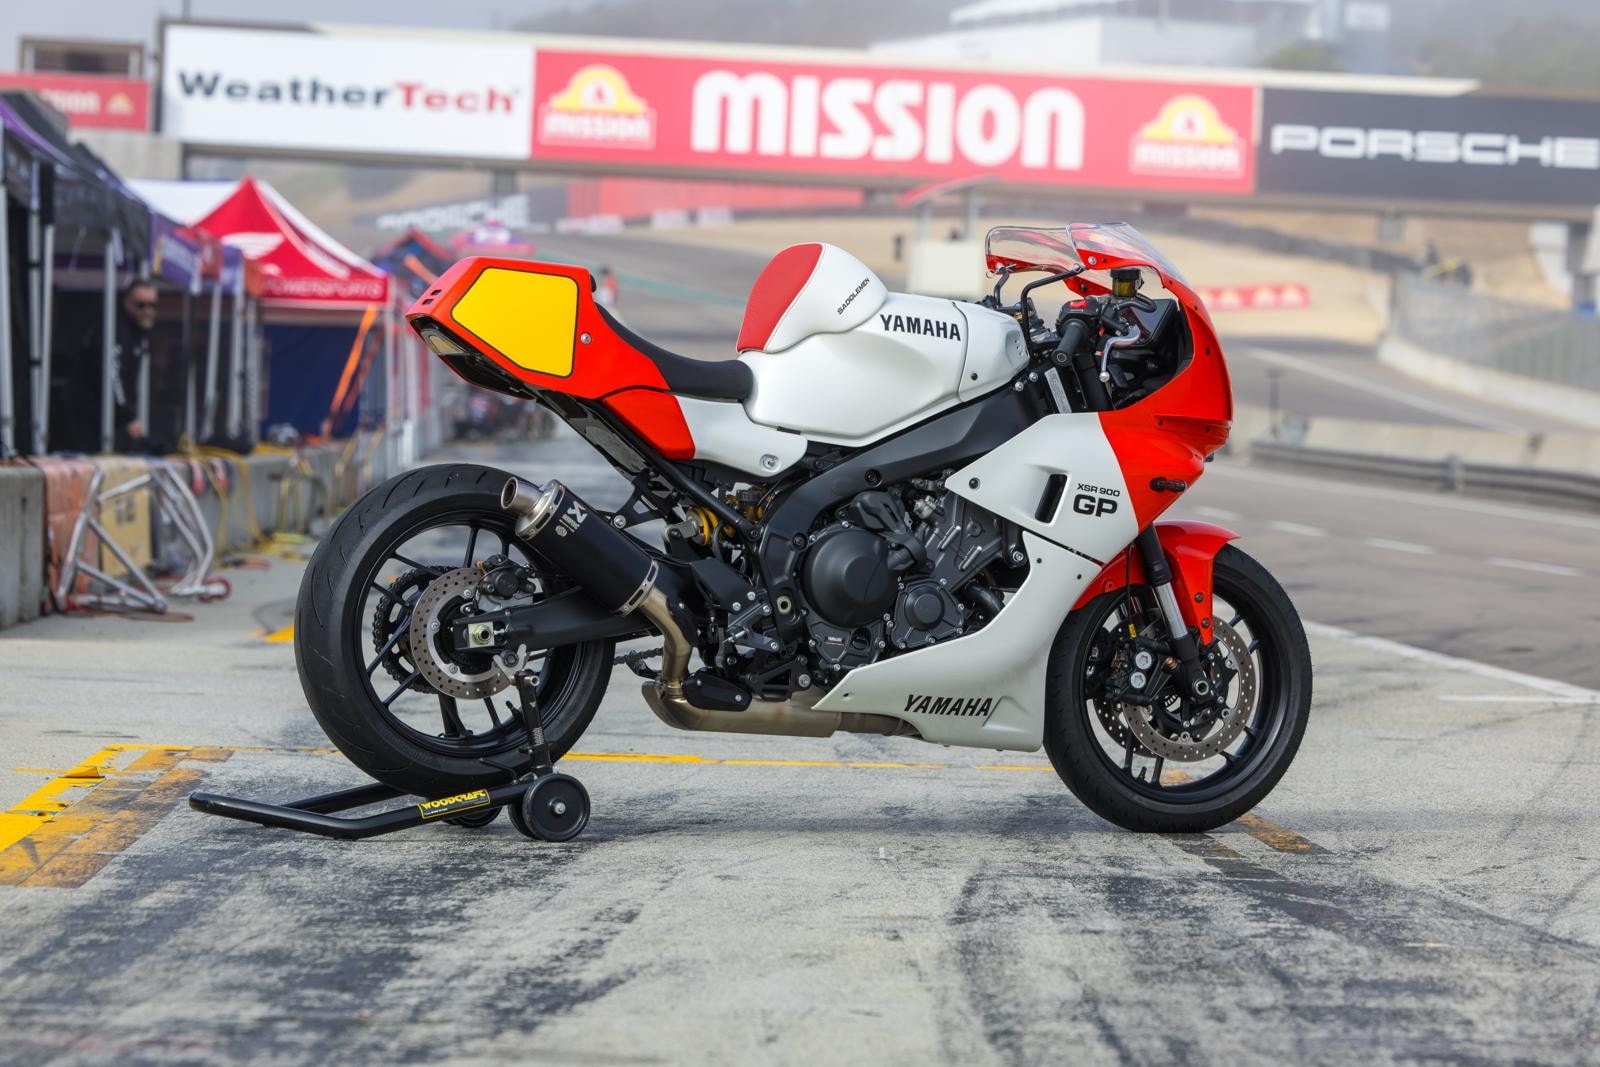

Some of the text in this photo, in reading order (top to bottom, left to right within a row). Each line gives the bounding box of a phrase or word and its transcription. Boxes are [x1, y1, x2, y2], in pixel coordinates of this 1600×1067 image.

[178, 71, 513, 113] WeatherTech
[690, 69, 1086, 171] MISSION
[1270, 124, 1600, 171] PORSCHE
[837, 278, 870, 315] SADDLEMEN
[880, 314, 961, 341] YAMAHA
[1077, 483, 1120, 497] XSR 900
[1073, 493, 1118, 518] GP
[904, 694, 993, 717] YAMAHA
[421, 789, 486, 809] WOODCRAFT
